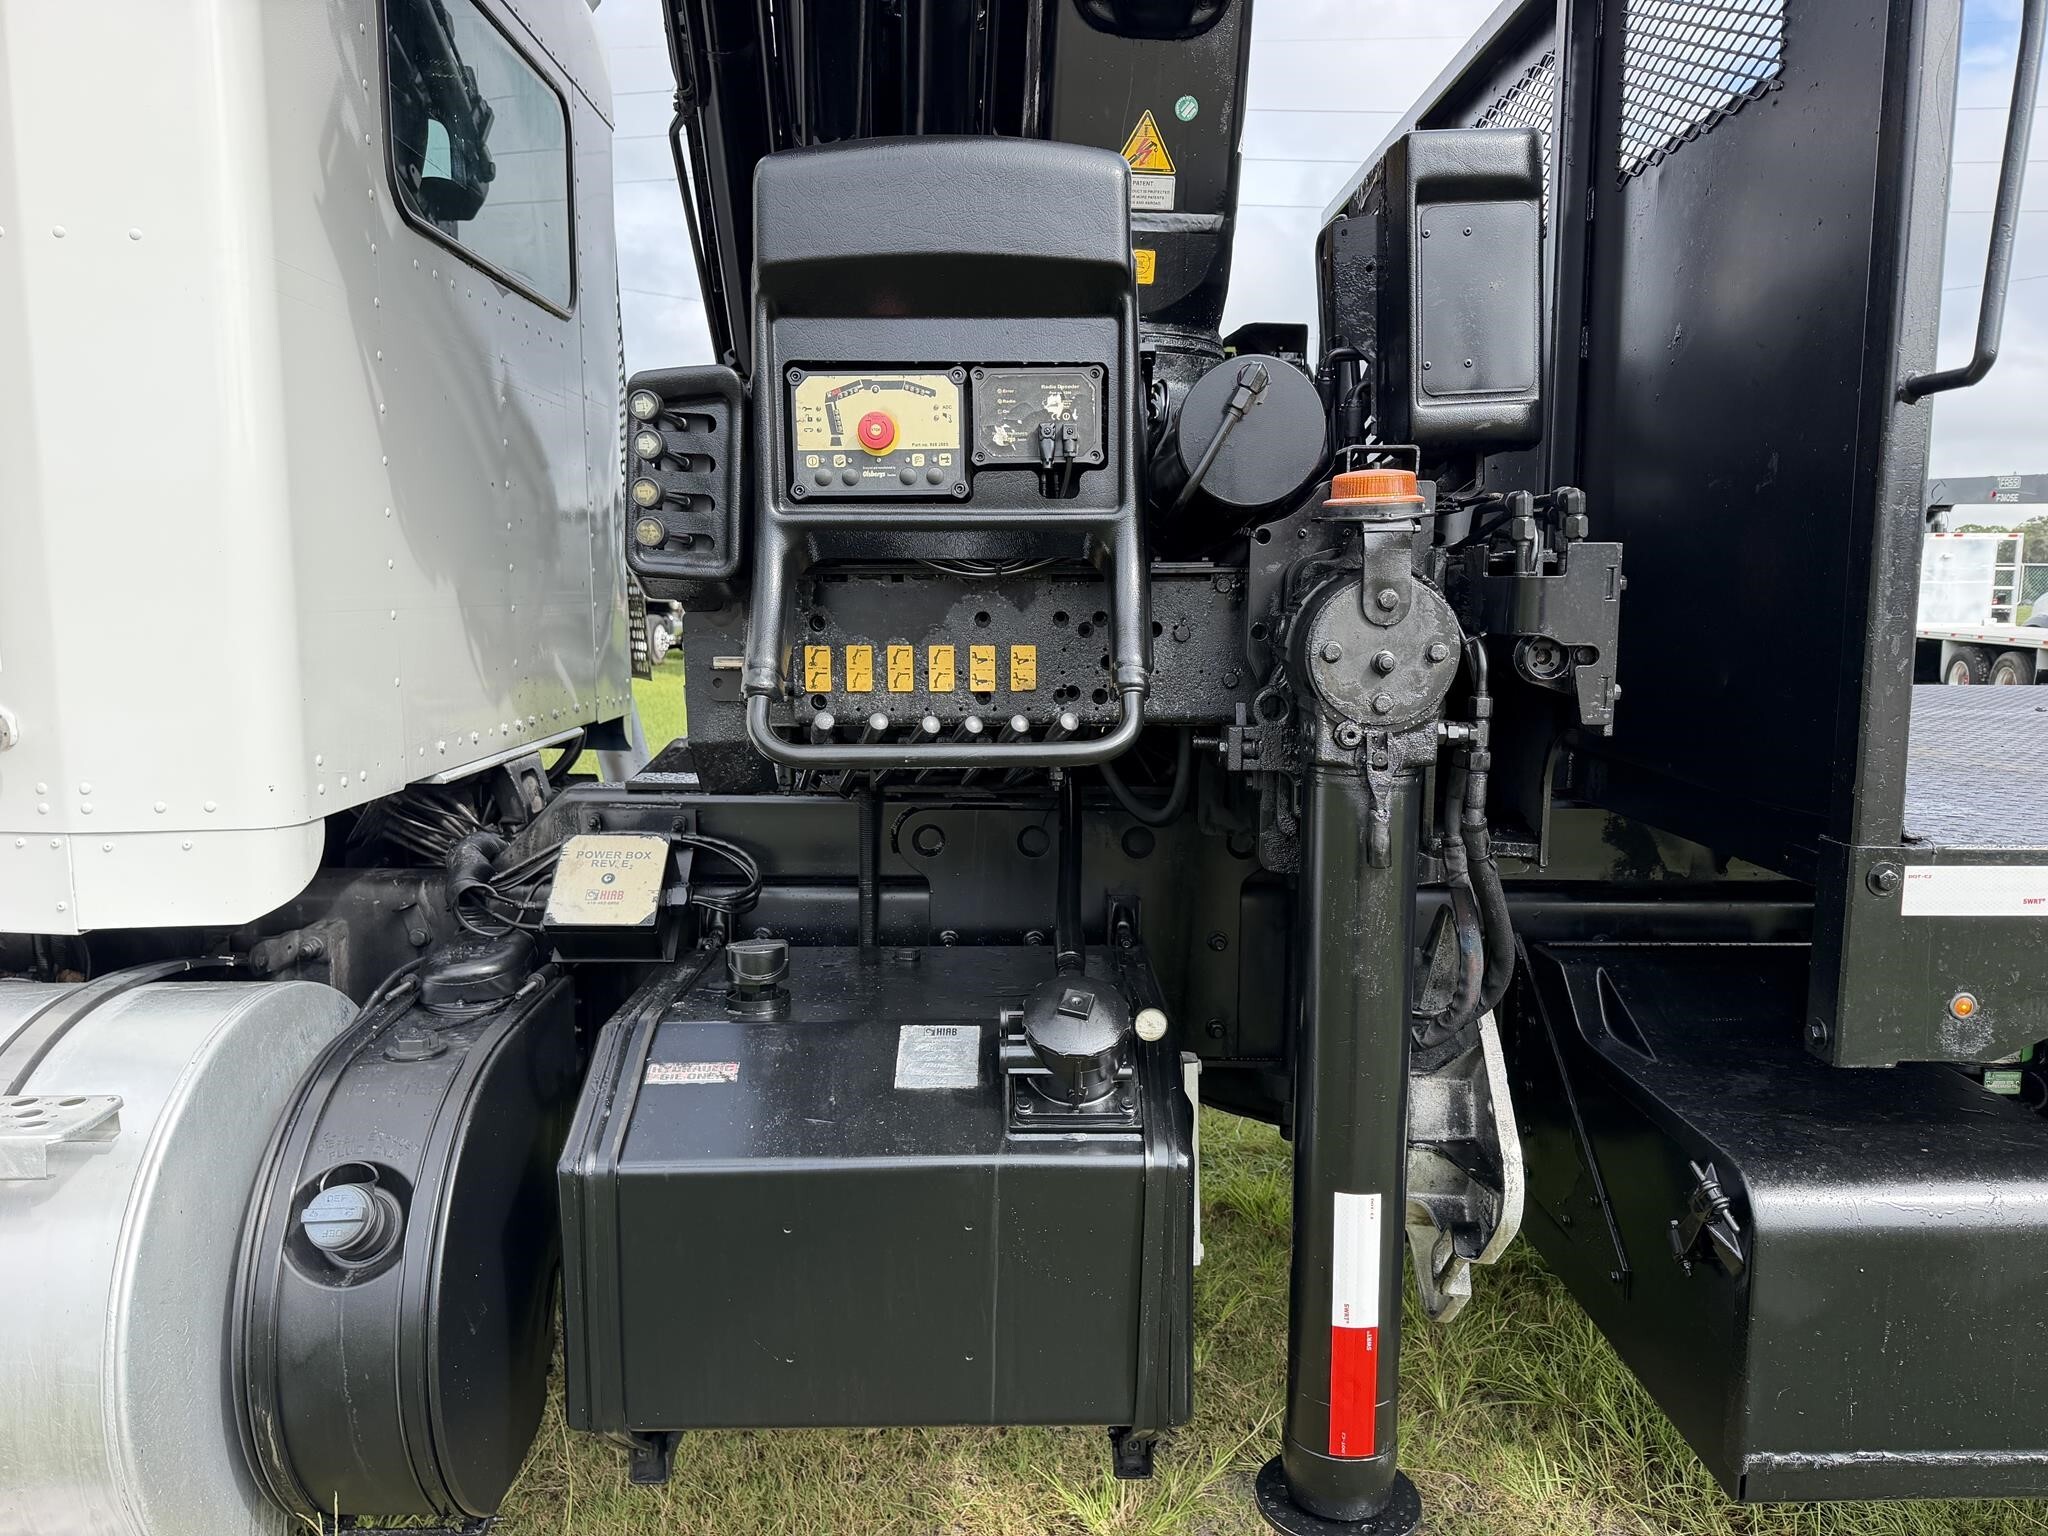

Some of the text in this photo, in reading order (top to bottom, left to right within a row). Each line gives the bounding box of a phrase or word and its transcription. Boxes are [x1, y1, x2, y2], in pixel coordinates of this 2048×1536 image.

[576, 850, 652, 860] POWER BOX
[599, 889, 625, 901] HIAB
[936, 1027, 958, 1036] HIAB
[327, 1194, 353, 1203] DEF
